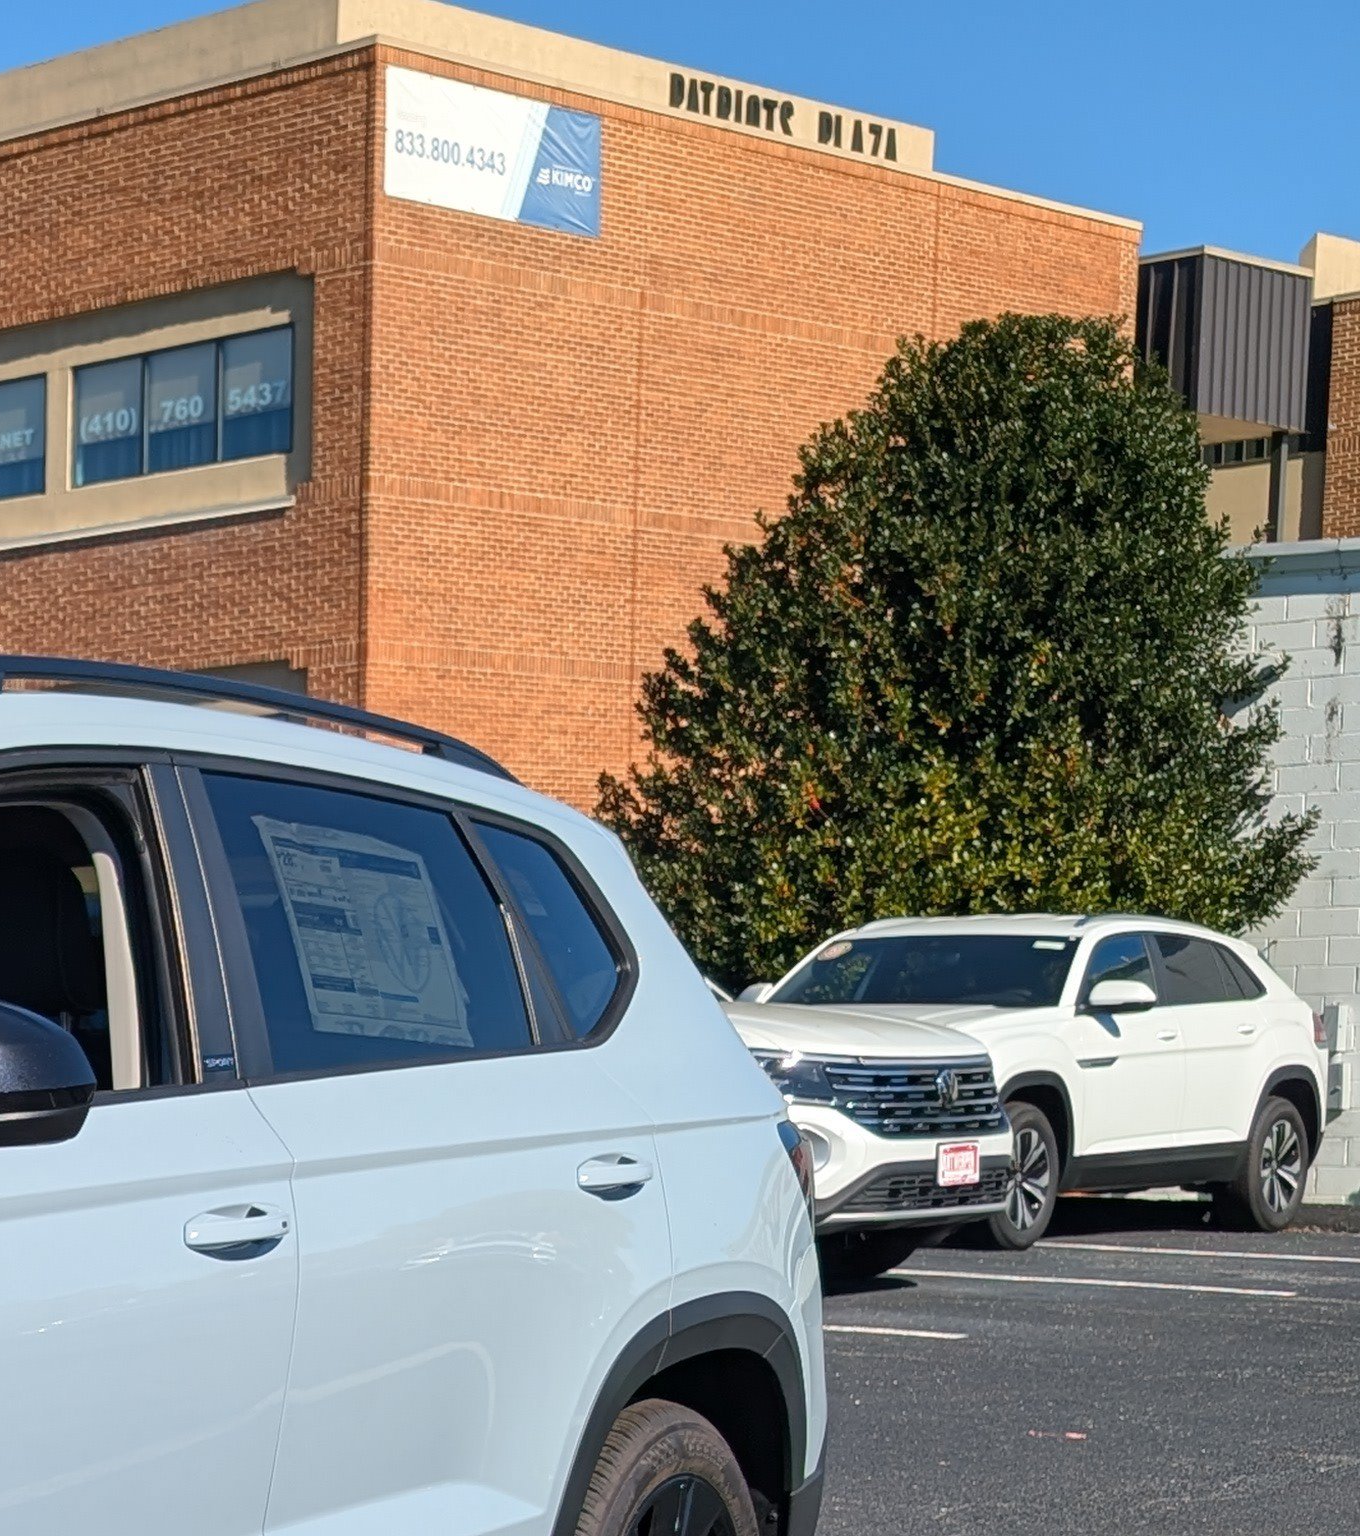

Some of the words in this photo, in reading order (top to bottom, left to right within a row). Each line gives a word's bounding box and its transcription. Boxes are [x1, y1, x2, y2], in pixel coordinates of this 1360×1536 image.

[668, 72, 795, 137] PATRIOTS
[817, 110, 898, 162] PLAZA
[394, 129, 507, 176] 833.800.4343
[551, 169, 593, 193] KIMCO
[81, 407, 137, 437] (410)
[160, 395, 204, 423] 760
[227, 380, 287, 412] 5437
